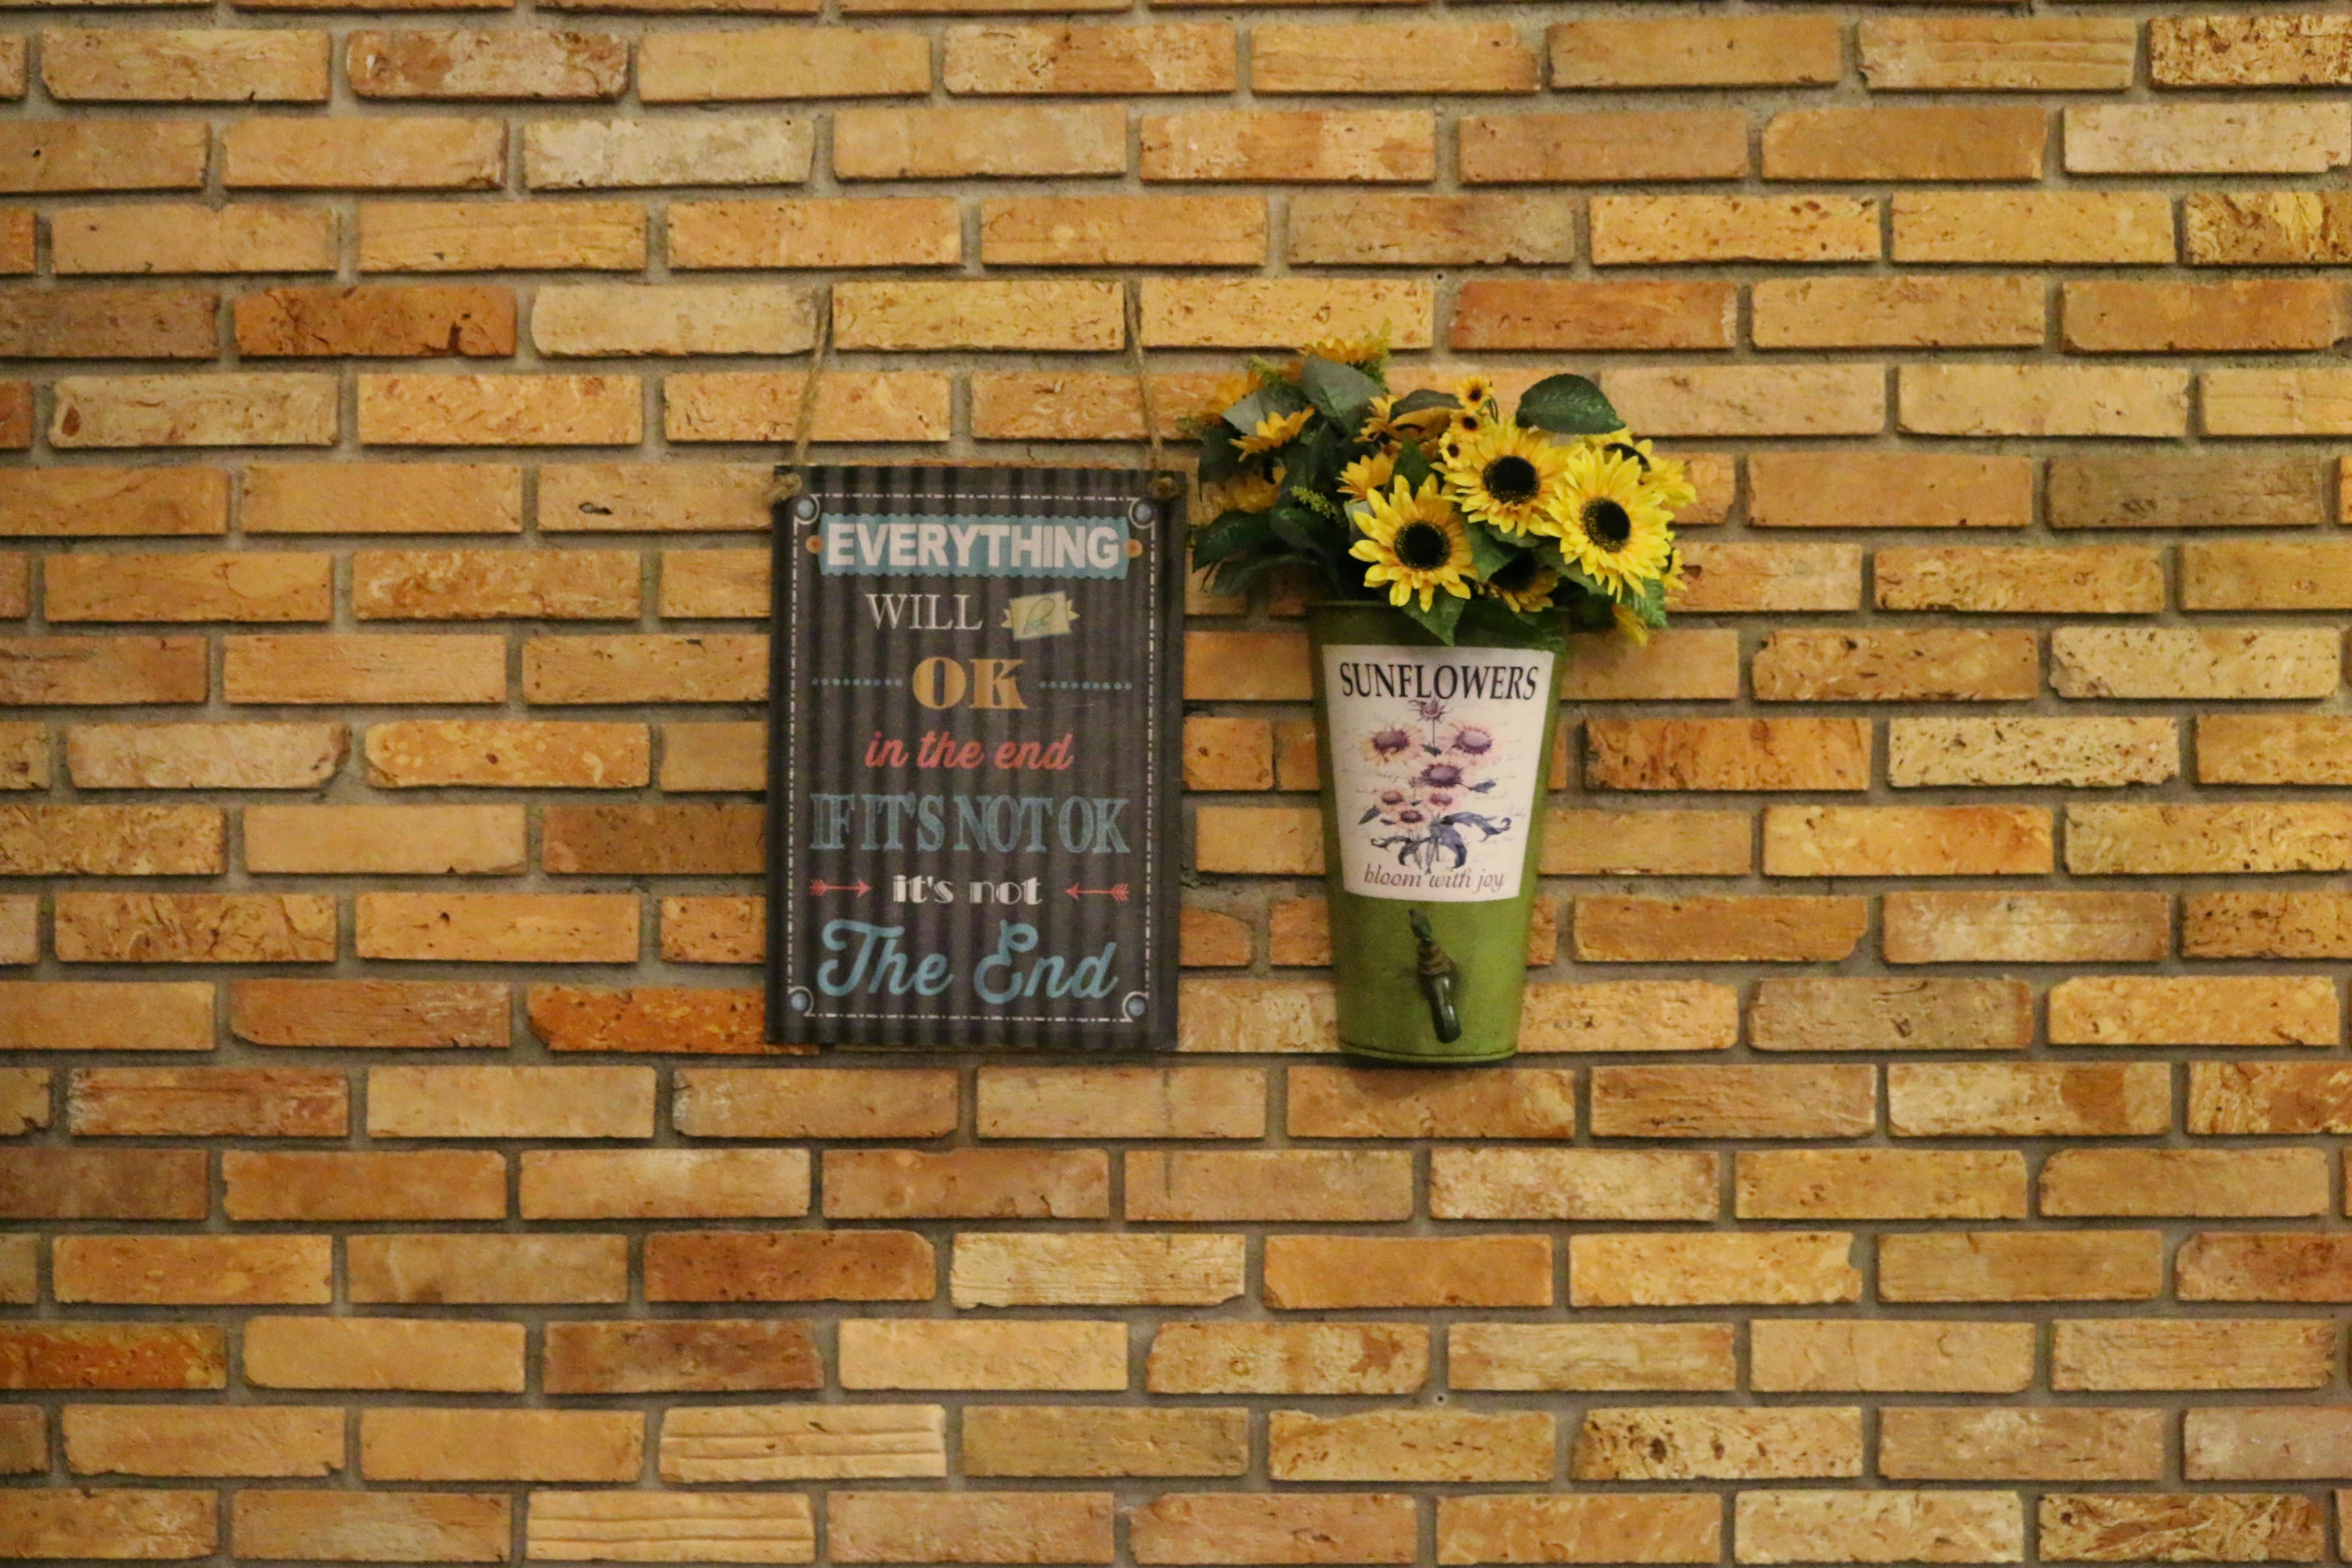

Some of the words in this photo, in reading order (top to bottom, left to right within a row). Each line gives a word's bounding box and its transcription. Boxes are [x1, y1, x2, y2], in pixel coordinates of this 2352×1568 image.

[827, 523, 1118, 568] EVERYTHING
[866, 594, 983, 630] WILL
[913, 657, 1027, 709] OK
[1339, 662, 1538, 699] SUNFLOWERS
[865, 732, 908, 768] in
[917, 731, 985, 769] the
[995, 733, 1074, 769] end
[810, 793, 855, 850] IF
[861, 793, 944, 851] IT'S
[953, 795, 1053, 852] NOT
[1059, 797, 1130, 854] OK
[893, 875, 953, 904] it's
[970, 876, 1042, 905] not
[1364, 863, 1421, 888] bloom
[1429, 867, 1472, 888] with
[1473, 869, 1504, 893] joy
[818, 919, 954, 996] The
[973, 920, 1118, 1004] End
